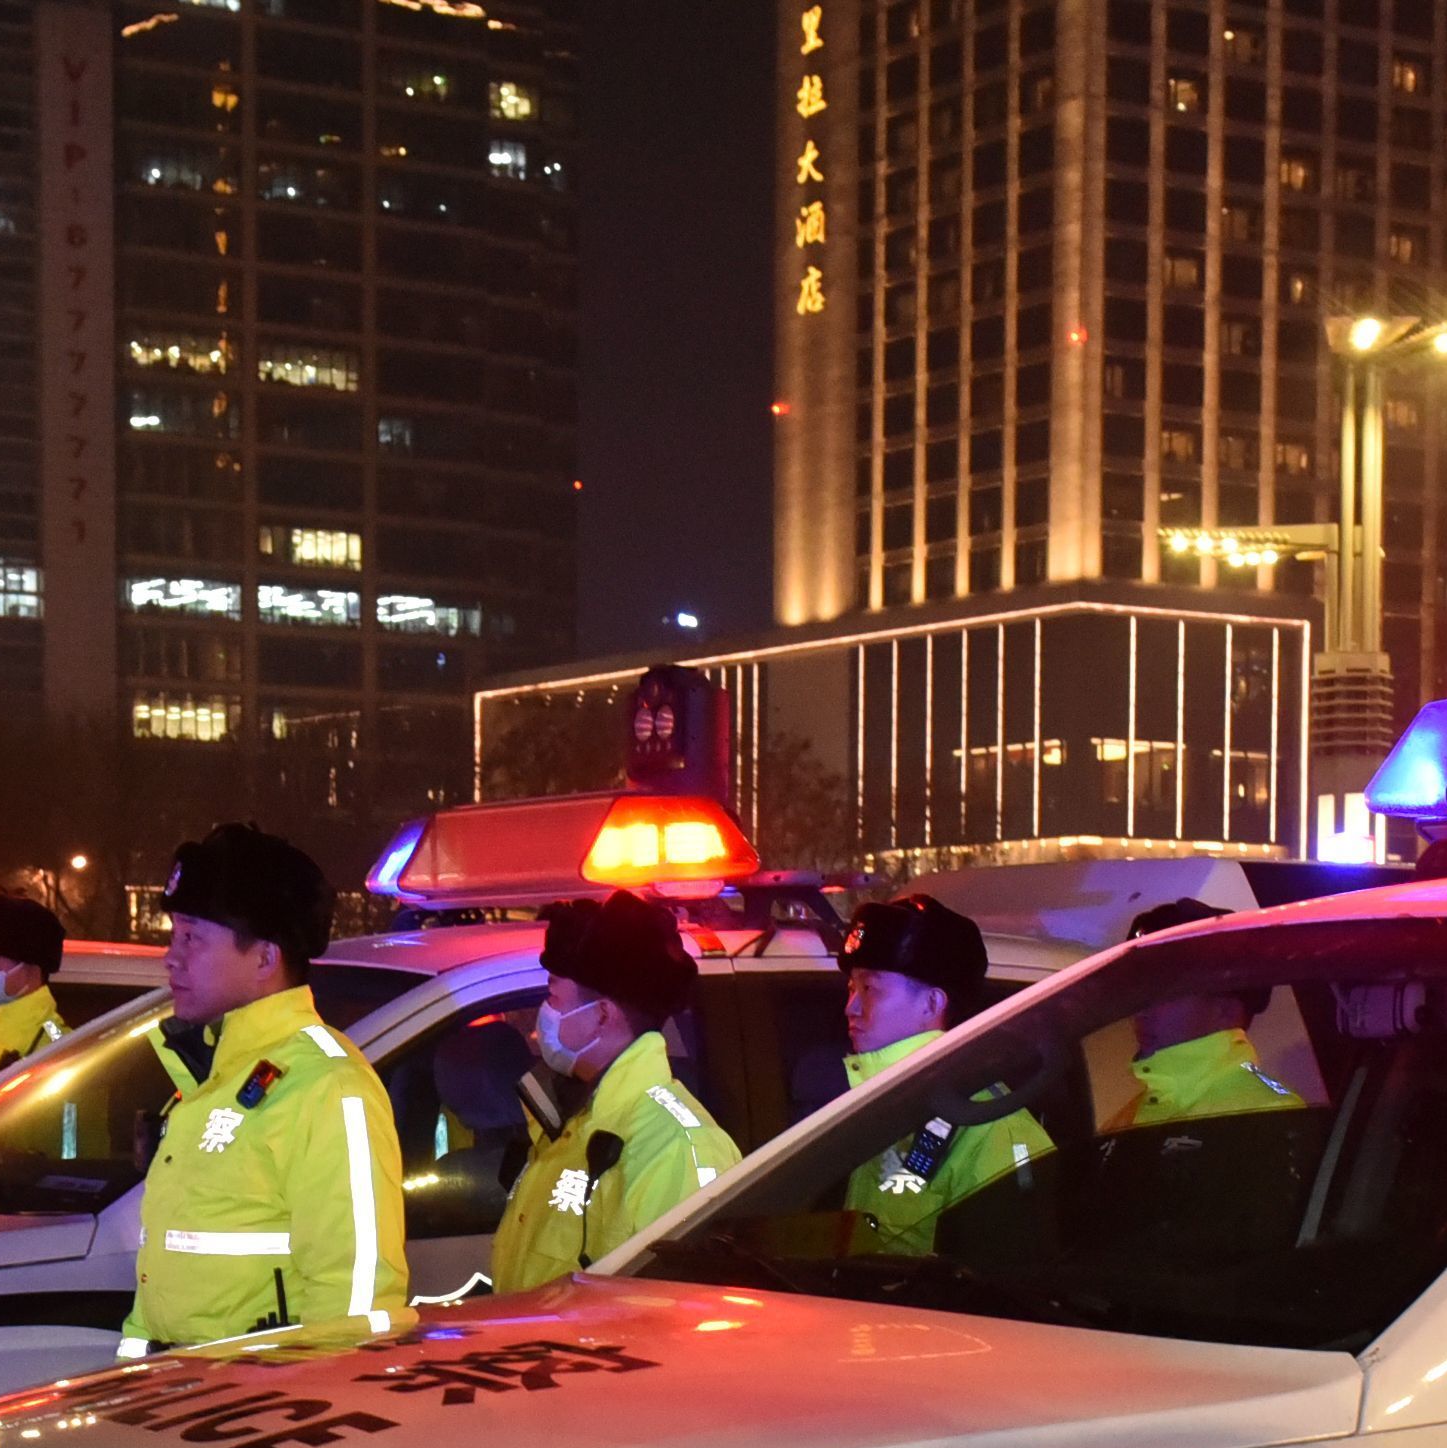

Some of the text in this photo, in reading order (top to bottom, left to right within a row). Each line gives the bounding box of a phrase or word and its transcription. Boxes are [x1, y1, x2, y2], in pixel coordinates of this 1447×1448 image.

[796, 5, 826, 315] 里拉大酒店
